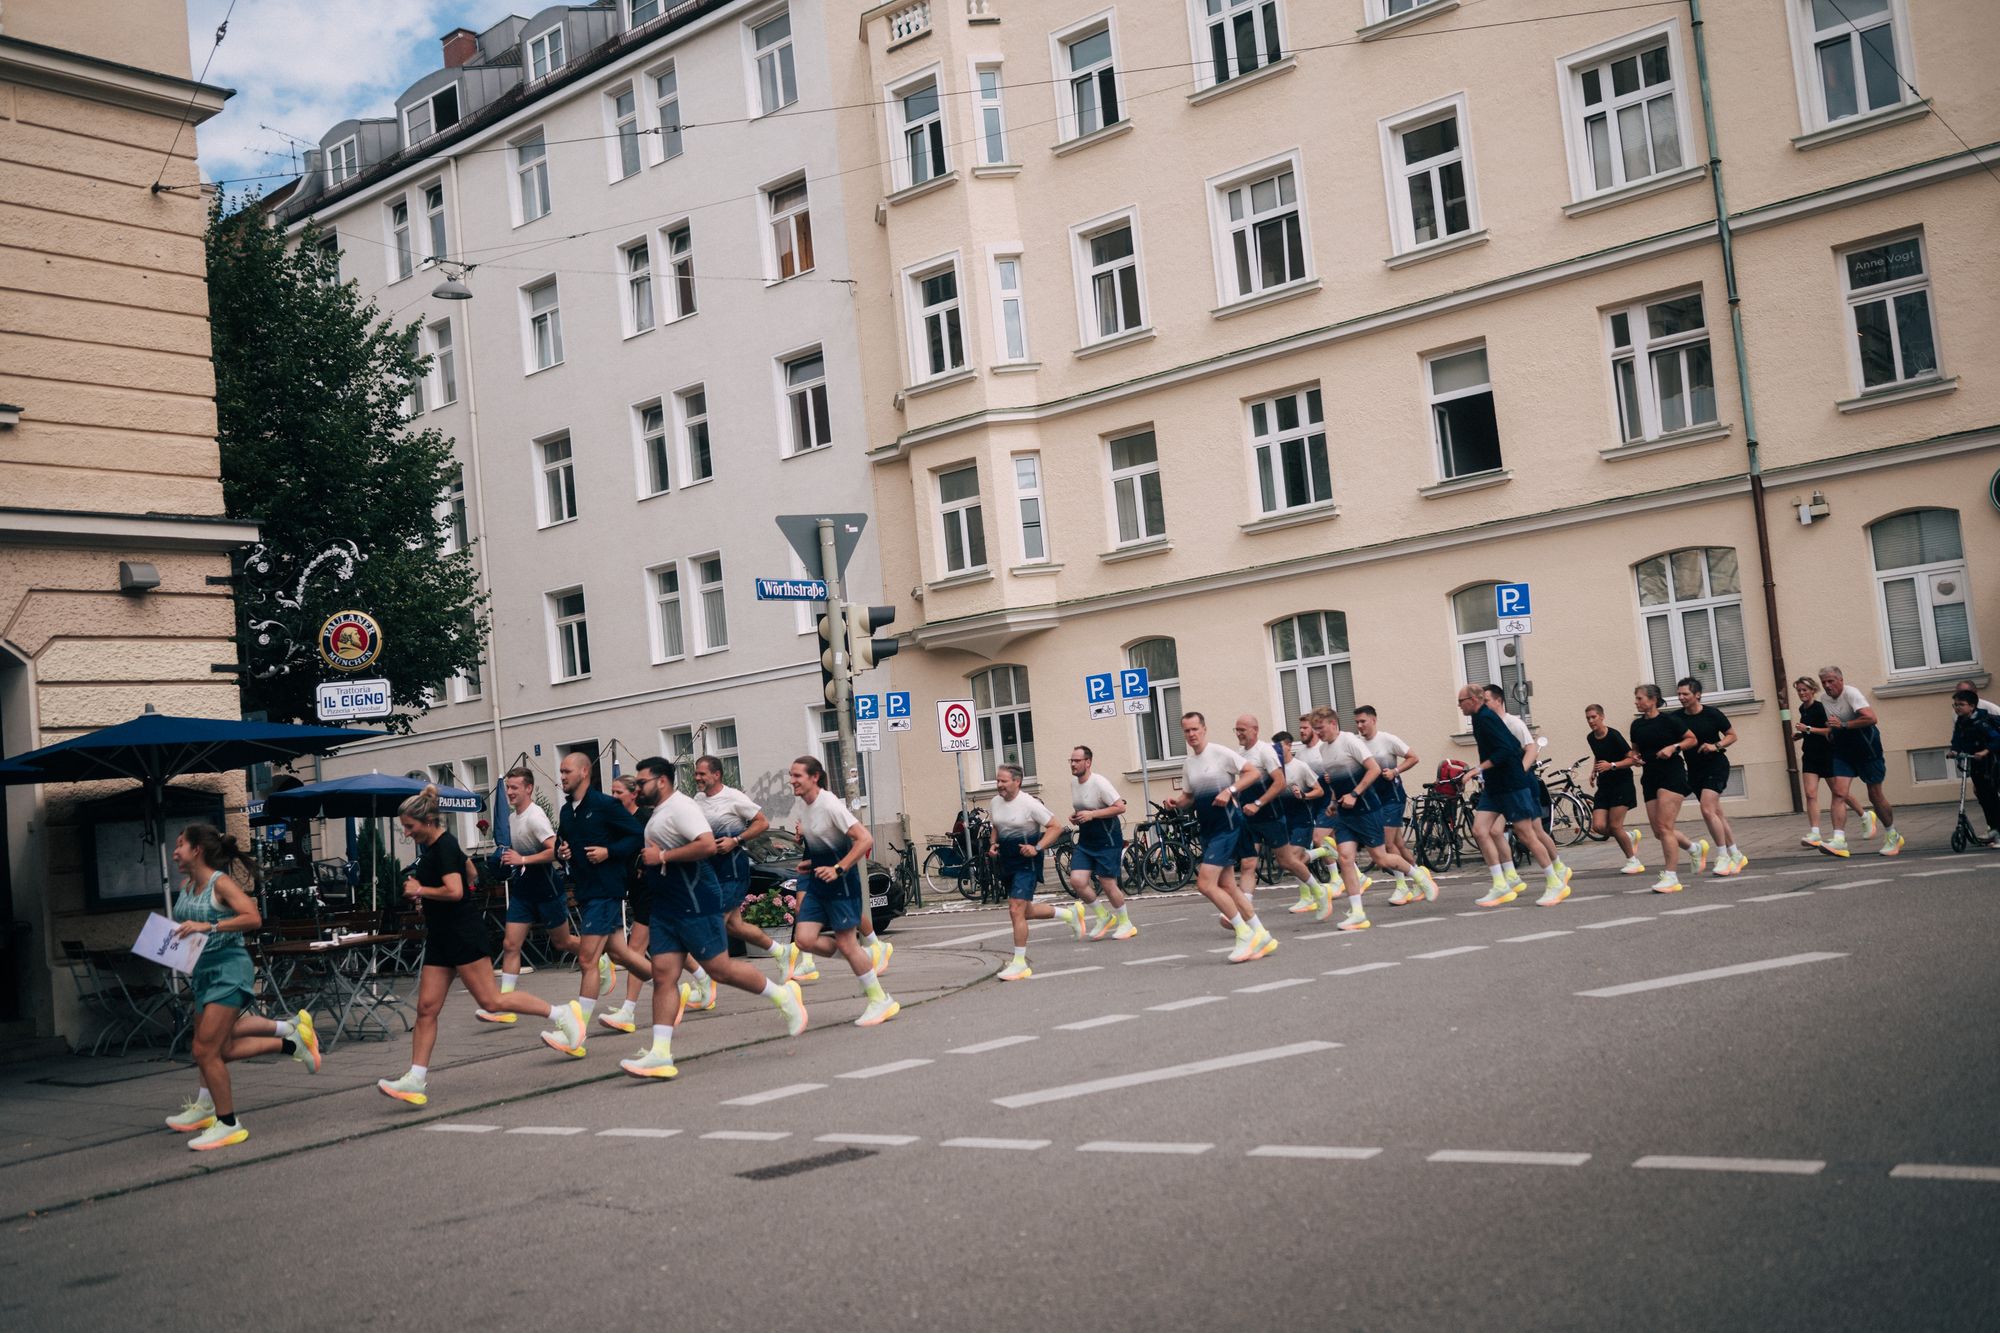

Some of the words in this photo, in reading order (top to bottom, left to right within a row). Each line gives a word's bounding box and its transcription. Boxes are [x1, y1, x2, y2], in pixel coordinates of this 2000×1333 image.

[1855, 259, 1884, 271] Anne
[1887, 251, 1914, 263] Vogt
[763, 581, 825, 599] Wörthstraße
[1501, 588, 1520, 612] P
[324, 614, 375, 637] PAULANER
[336, 686, 371, 695] Trattoria
[1089, 678, 1105, 700] P
[1124, 672, 1140, 695] P
[323, 697, 336, 708] IL
[341, 693, 384, 707] CIGNO
[858, 697, 872, 717] P
[890, 695, 903, 715] P
[326, 706, 351, 715] Pizzeria
[950, 713, 966, 729] 30
[950, 739, 971, 749] ZONE
[438, 796, 477, 808] PAULANER
